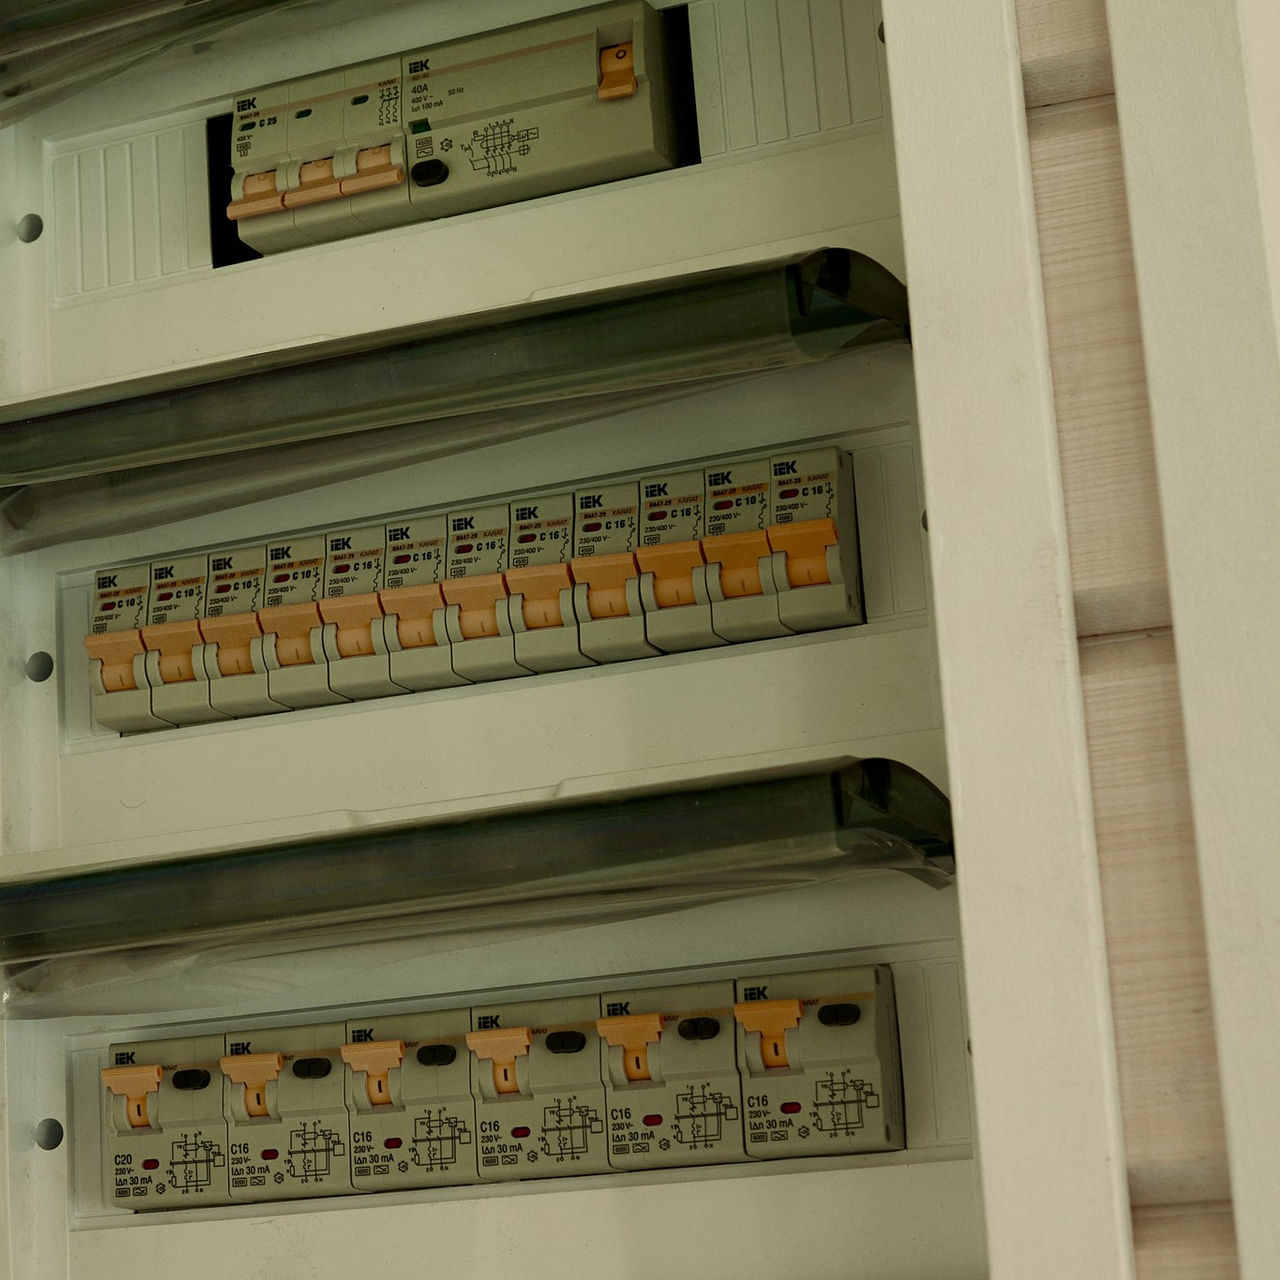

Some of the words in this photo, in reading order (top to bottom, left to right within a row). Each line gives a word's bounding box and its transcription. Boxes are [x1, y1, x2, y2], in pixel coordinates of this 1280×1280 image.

[411, 83, 429, 94] 40A
[447, 88, 456, 96] 50
[267, 116, 278, 126] 25
[747, 1095, 768, 1108] C16
[611, 1108, 632, 1120] C16
[480, 1120, 500, 1133] C16
[766, 1119, 777, 1129] 30
[778, 1118, 794, 1128] mA
[353, 1131, 372, 1143] C16
[627, 1131, 639, 1141] 30
[641, 1130, 655, 1140] mA
[230, 1143, 249, 1155] C16
[497, 1144, 508, 1153] 30
[509, 1143, 523, 1152] mA
[114, 1154, 132, 1166] C20
[368, 1154, 380, 1163] 30
[381, 1153, 394, 1162] mA
[246, 1165, 257, 1175] 30
[257, 1164, 271, 1174] mA
[129, 1176, 140, 1185] 30
[140, 1175, 153, 1185] mA
